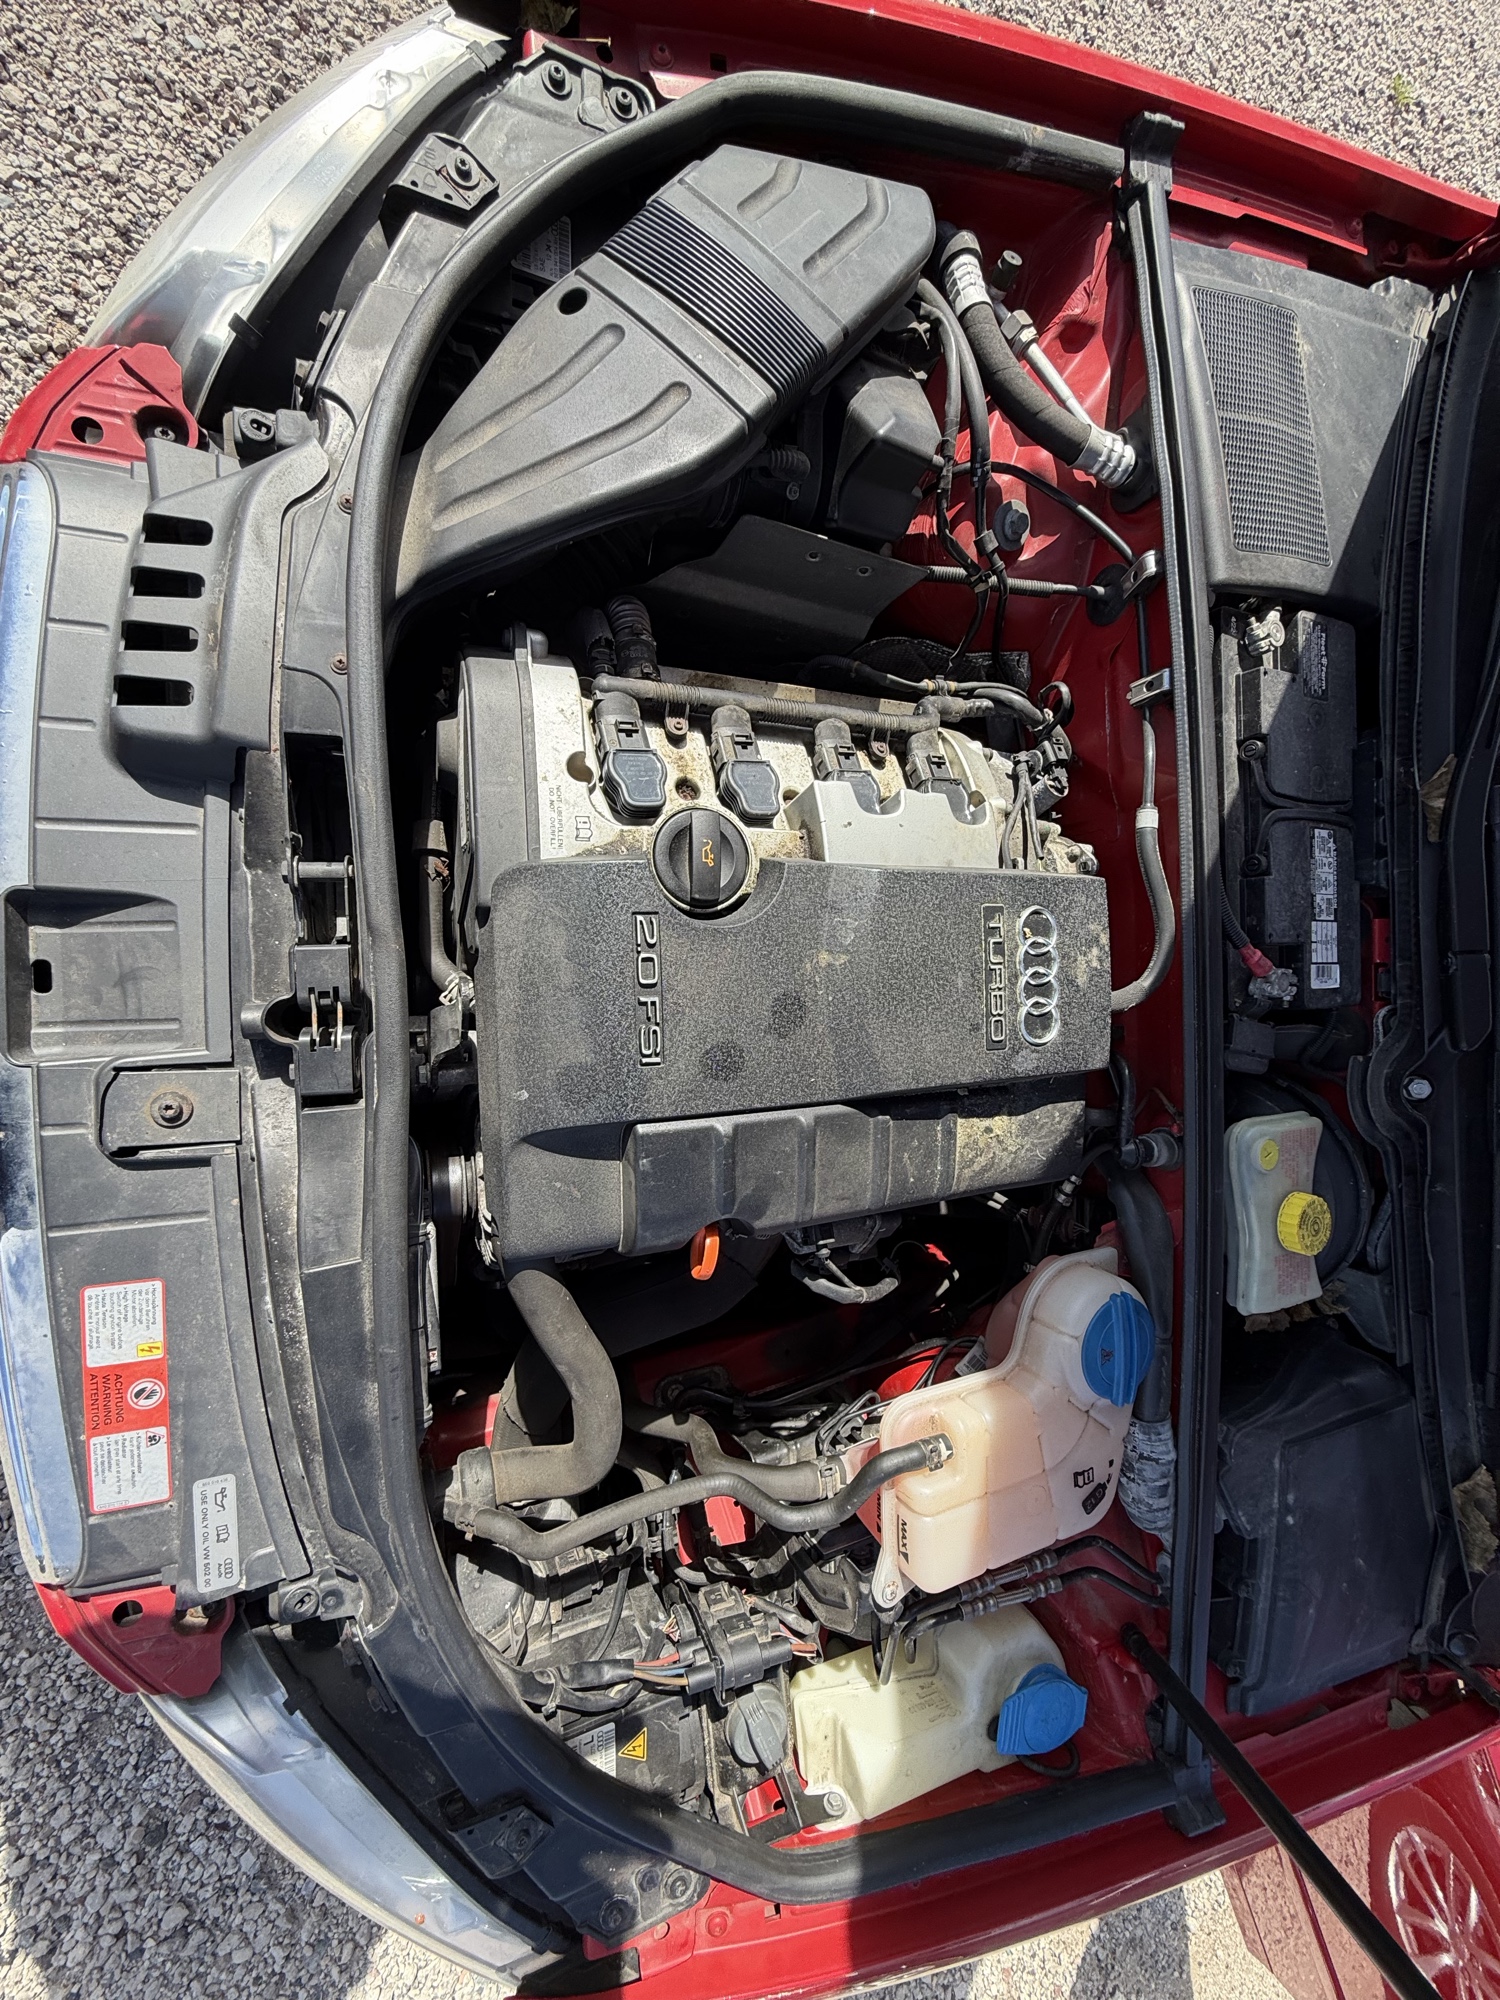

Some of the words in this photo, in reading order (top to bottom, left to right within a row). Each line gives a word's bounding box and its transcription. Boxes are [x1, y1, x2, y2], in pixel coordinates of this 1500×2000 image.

[549, 788, 554, 796] DO
[636, 915, 657, 986] 2.0
[988, 913, 1005, 1042] TURBO
[638, 997, 661, 1064] FSI
[90, 1374, 100, 1430] ATTENTION
[102, 1374, 112, 1426] WARNING
[114, 1374, 124, 1423] ACHTUNG
[200, 1490, 208, 1505] USE
[201, 1508, 209, 1529] ONLY
[202, 1532, 210, 1544] OIL
[203, 1547, 210, 1560] VW
[204, 1578, 211, 1587] 00
[583, 1735, 594, 1746] L
